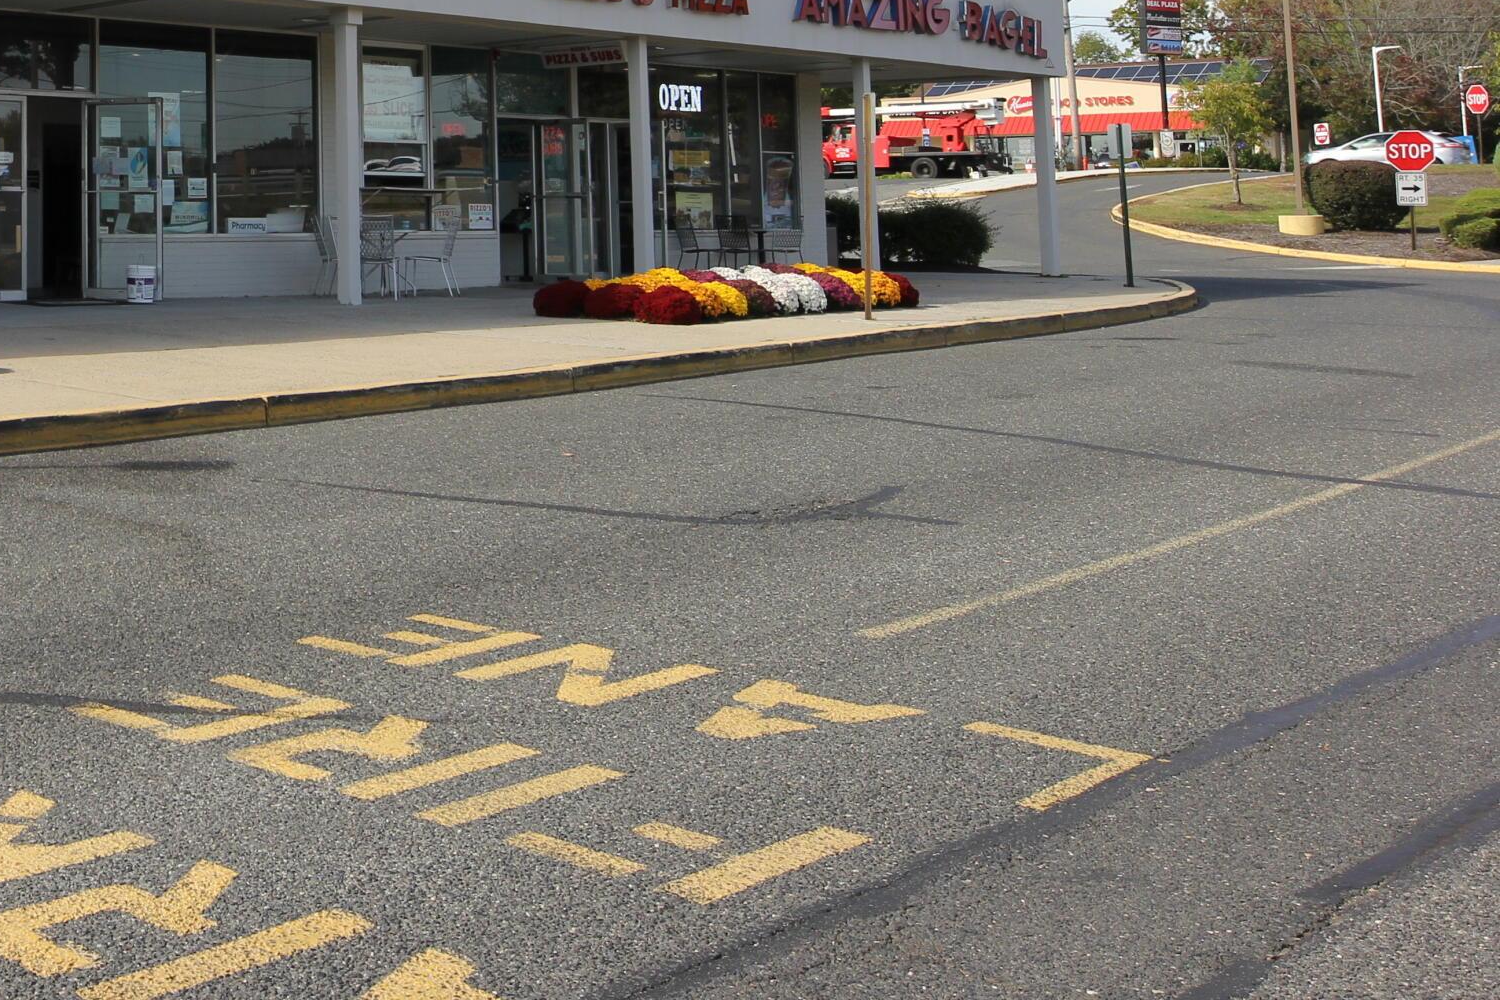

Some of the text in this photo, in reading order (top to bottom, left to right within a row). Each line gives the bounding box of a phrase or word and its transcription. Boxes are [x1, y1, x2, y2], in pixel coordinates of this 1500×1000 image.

[960, 0, 1048, 60] BAGEL
[545, 52, 578, 64] PIZZA
[580, 52, 589, 62] &
[590, 49, 622, 62] SUBS
[659, 83, 702, 112] OPEN
[1085, 96, 1135, 107] STORES
[1468, 93, 1486, 105] STOP
[1388, 143, 1431, 159] STOP
[231, 221, 267, 231] Pharmacy
